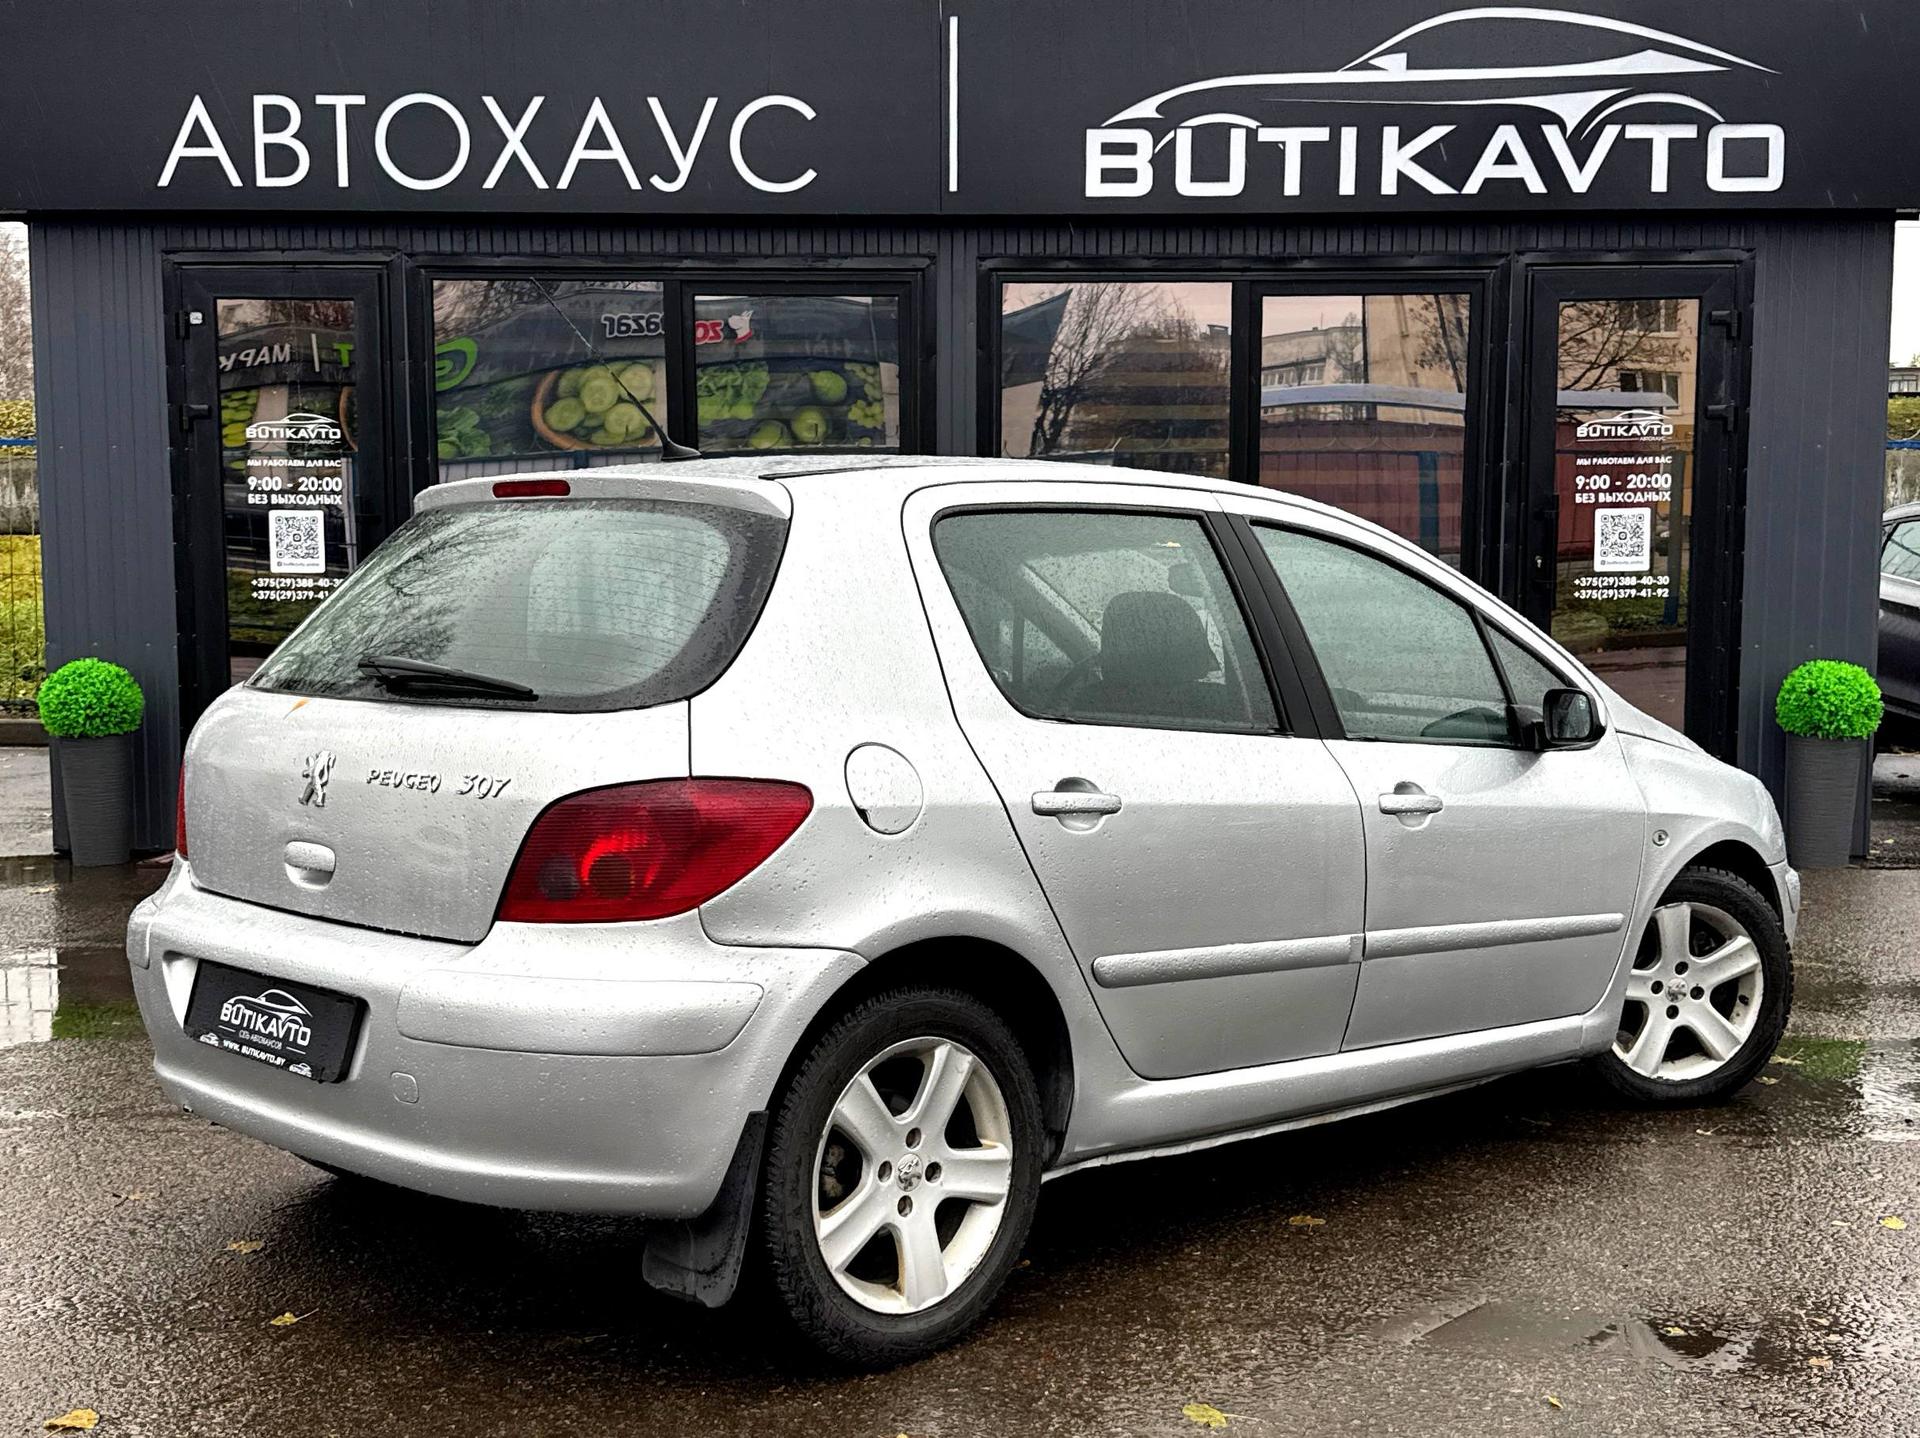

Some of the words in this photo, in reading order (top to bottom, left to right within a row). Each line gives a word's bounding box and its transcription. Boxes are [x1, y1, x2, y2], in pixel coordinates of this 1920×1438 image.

[158, 93, 818, 193] АВТОХАУС
[1085, 122, 1785, 198] BUTIKAVTO
[246, 427, 341, 439] BUTIKAVTO
[1577, 424, 1673, 438] BUTIKAVTO
[247, 459, 261, 467] МЫ
[263, 459, 305, 467] РАБОТАЕМ
[306, 459, 323, 468] ДЛЯ
[324, 459, 341, 467] ВАС
[1576, 458, 1591, 466] МЫ
[1592, 457, 1635, 465] РАБОТАЕМ
[1636, 456, 1653, 465] ДЛЯ
[1655, 456, 1673, 464] ВАС
[247, 476, 282, 491] 9:00
[298, 476, 342, 492] 20:00
[1575, 475, 1611, 490] 9:00
[1626, 474, 1672, 489] 20:00
[247, 494, 268, 505] БЕЗ
[271, 494, 342, 505] ВЫХОДНЫХ
[1575, 492, 1596, 504] БЕЗ
[1598, 491, 1671, 503] ВЫХОДНЫХ
[1573, 576, 1670, 588] +375(29)388-40-30
[1573, 588, 1669, 600] +375(29)379-41-92
[456, 773, 511, 799] 307
[219, 1003, 312, 1046] BUTIKAVTO
